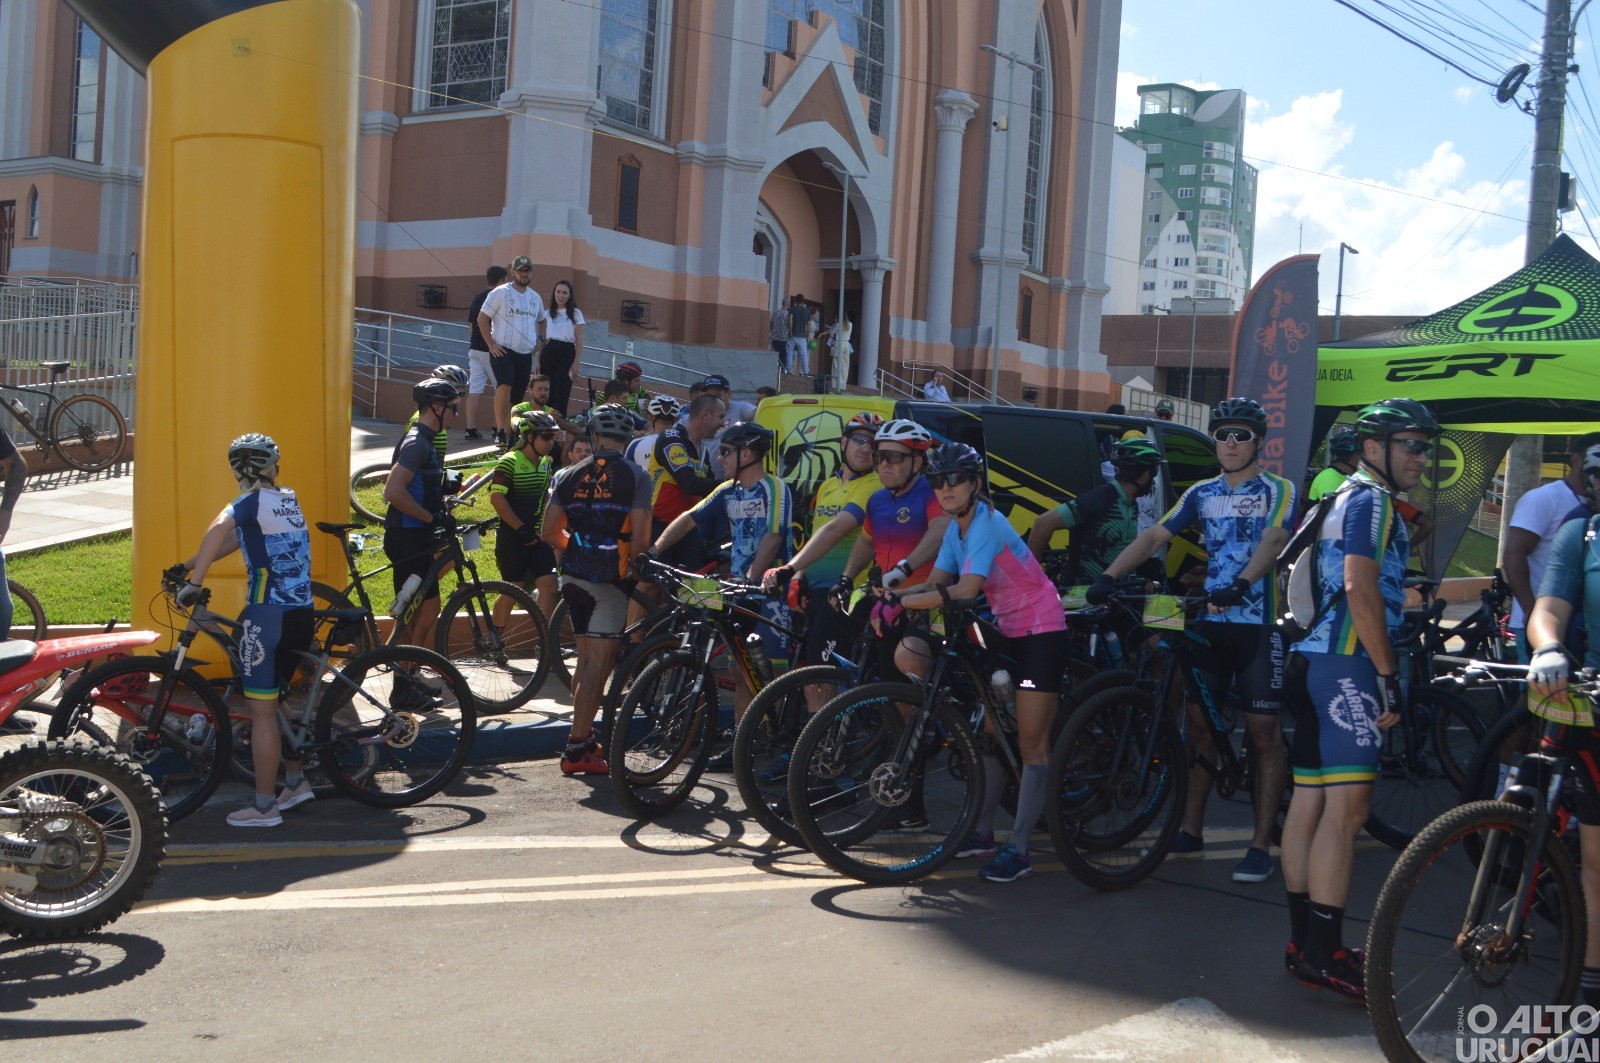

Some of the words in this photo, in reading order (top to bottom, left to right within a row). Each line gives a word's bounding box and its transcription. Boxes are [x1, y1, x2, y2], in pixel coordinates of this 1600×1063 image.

[1329, 368, 1355, 381] IDEIA.
[1385, 352, 1567, 382] ERT
[1262, 360, 1288, 428] Bike
[66, 643, 117, 658] DUNLOP
[243, 624, 262, 677] MARRETA'S
[1270, 667, 1284, 689] Giro
[1337, 677, 1373, 747] MARRETA'S
